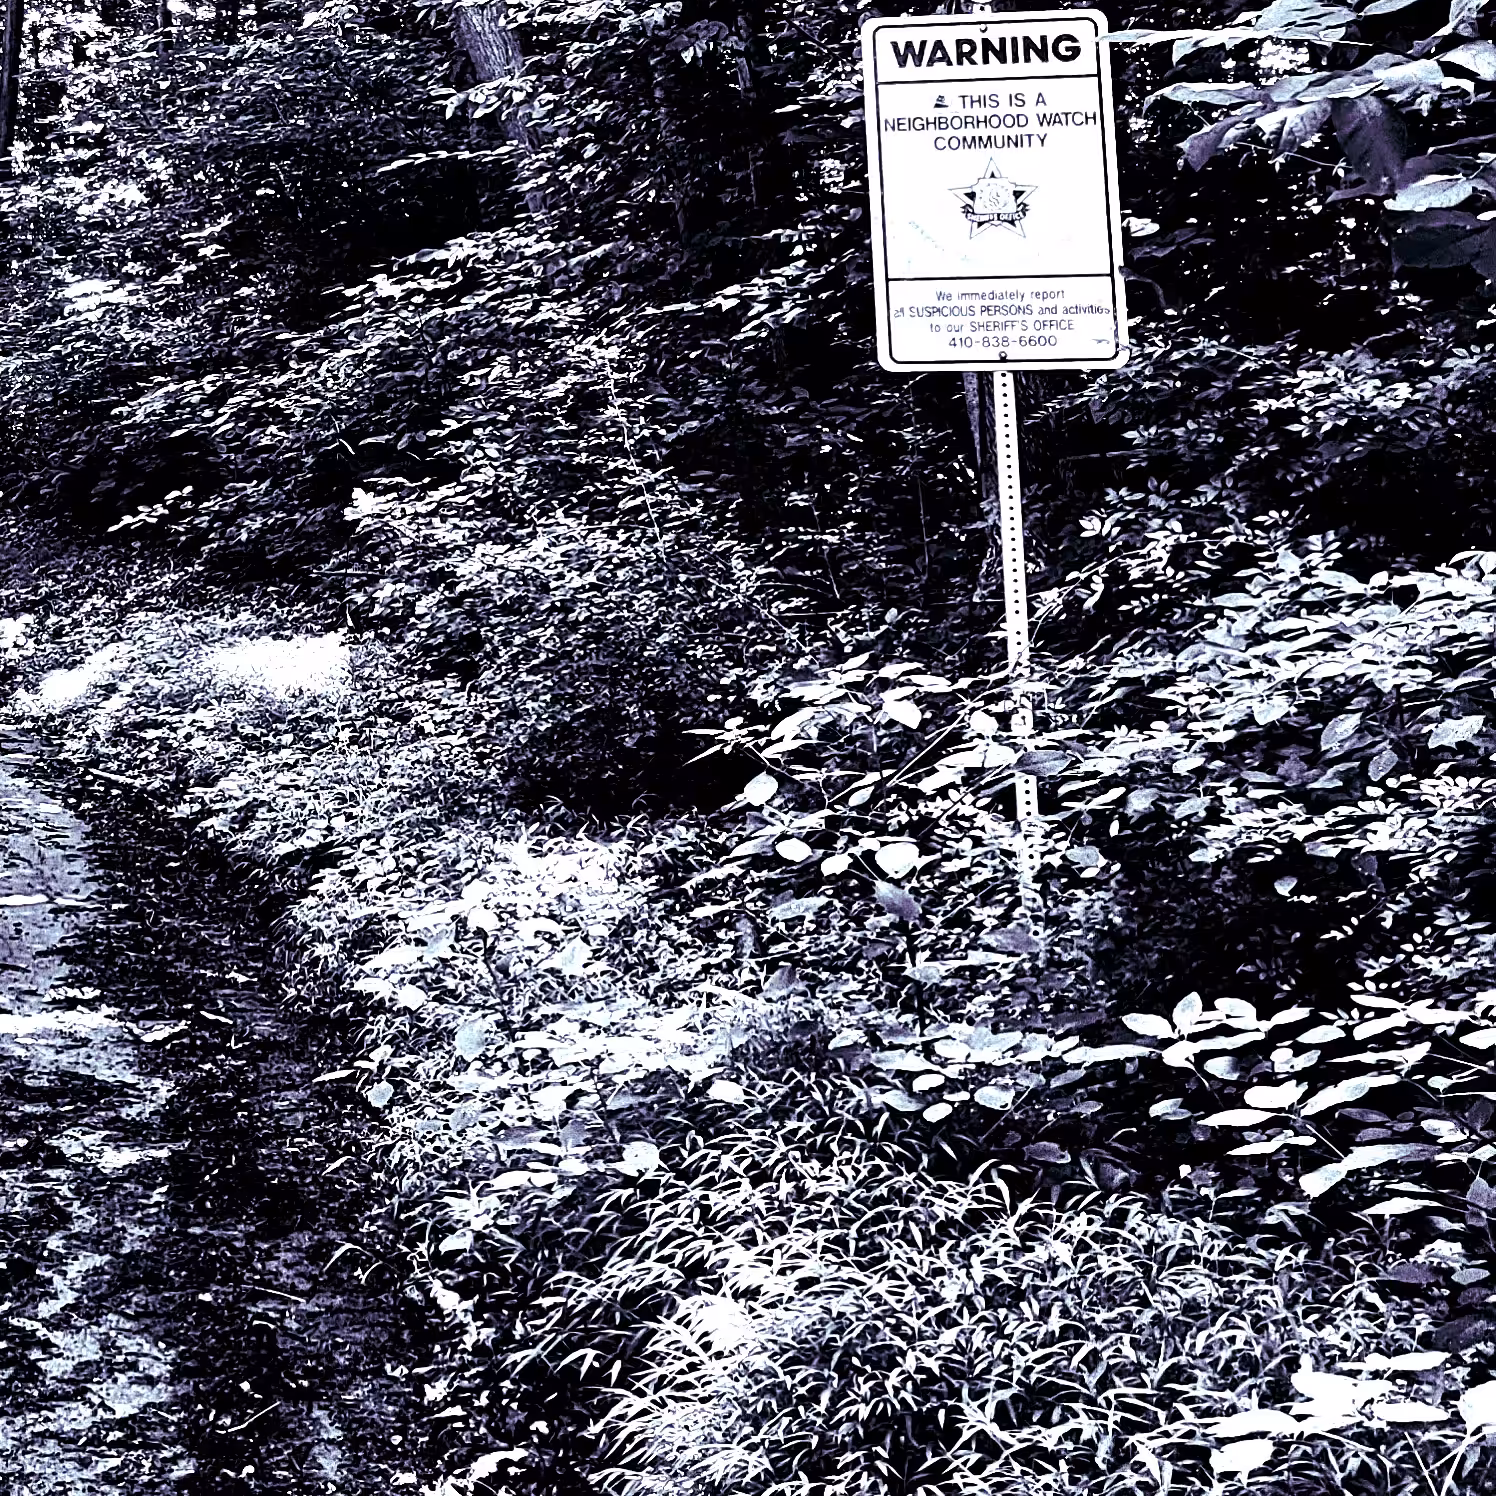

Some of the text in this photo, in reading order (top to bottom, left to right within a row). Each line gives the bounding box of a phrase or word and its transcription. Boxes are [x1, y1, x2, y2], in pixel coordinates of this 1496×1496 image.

[890, 34, 1081, 68] WARNING
[958, 92, 1047, 109] THIS IS A
[884, 111, 1097, 132] NEIGHBORHOOD WATCH
[934, 133, 1048, 150] COMMUNITY
[936, 289, 1065, 302] We immediately report
[909, 305, 976, 317] SUSPICIOUS
[980, 304, 1033, 316] PERSONS
[1038, 304, 1057, 315] and
[1062, 303, 1110, 315] activities
[930, 319, 1074, 332] to our SHERIFF'S OFFICE
[949, 335, 1057, 348] 410-838-6600
